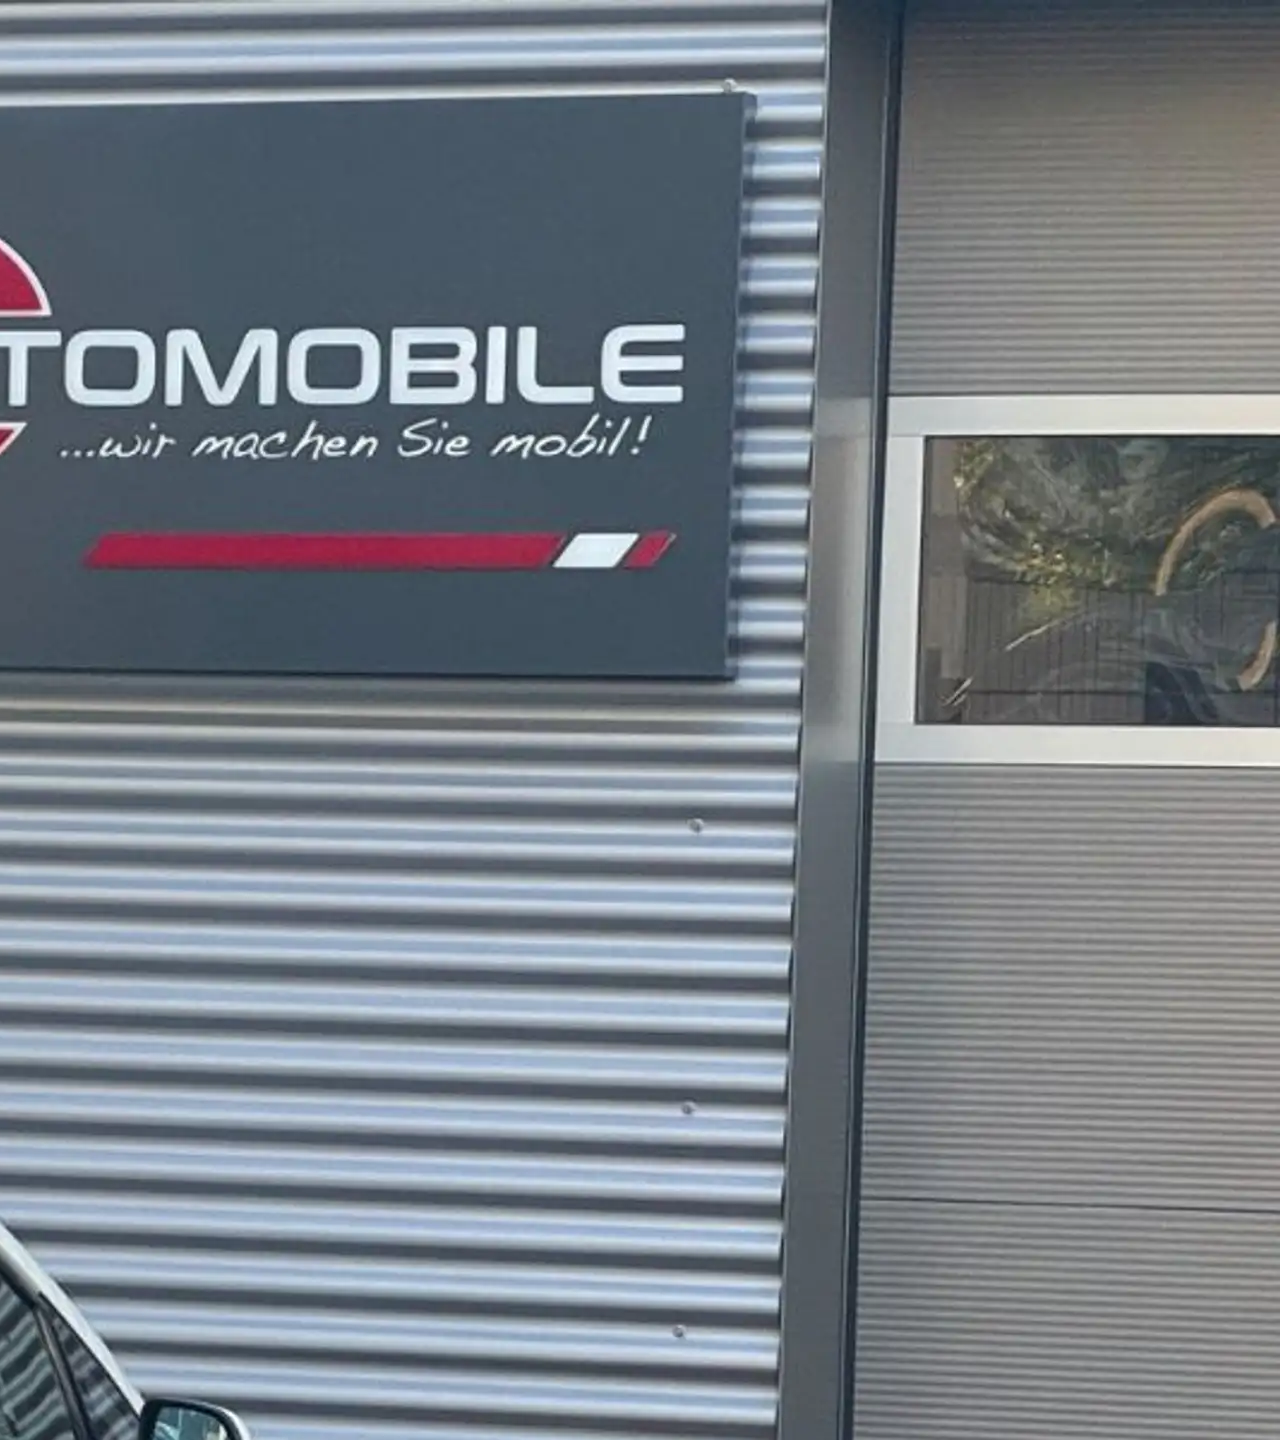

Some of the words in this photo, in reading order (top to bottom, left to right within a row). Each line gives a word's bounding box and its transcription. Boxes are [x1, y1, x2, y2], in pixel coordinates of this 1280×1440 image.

[192, 420, 378, 460] machen
[397, 417, 471, 457] Sie
[490, 412, 653, 459] mobil!
